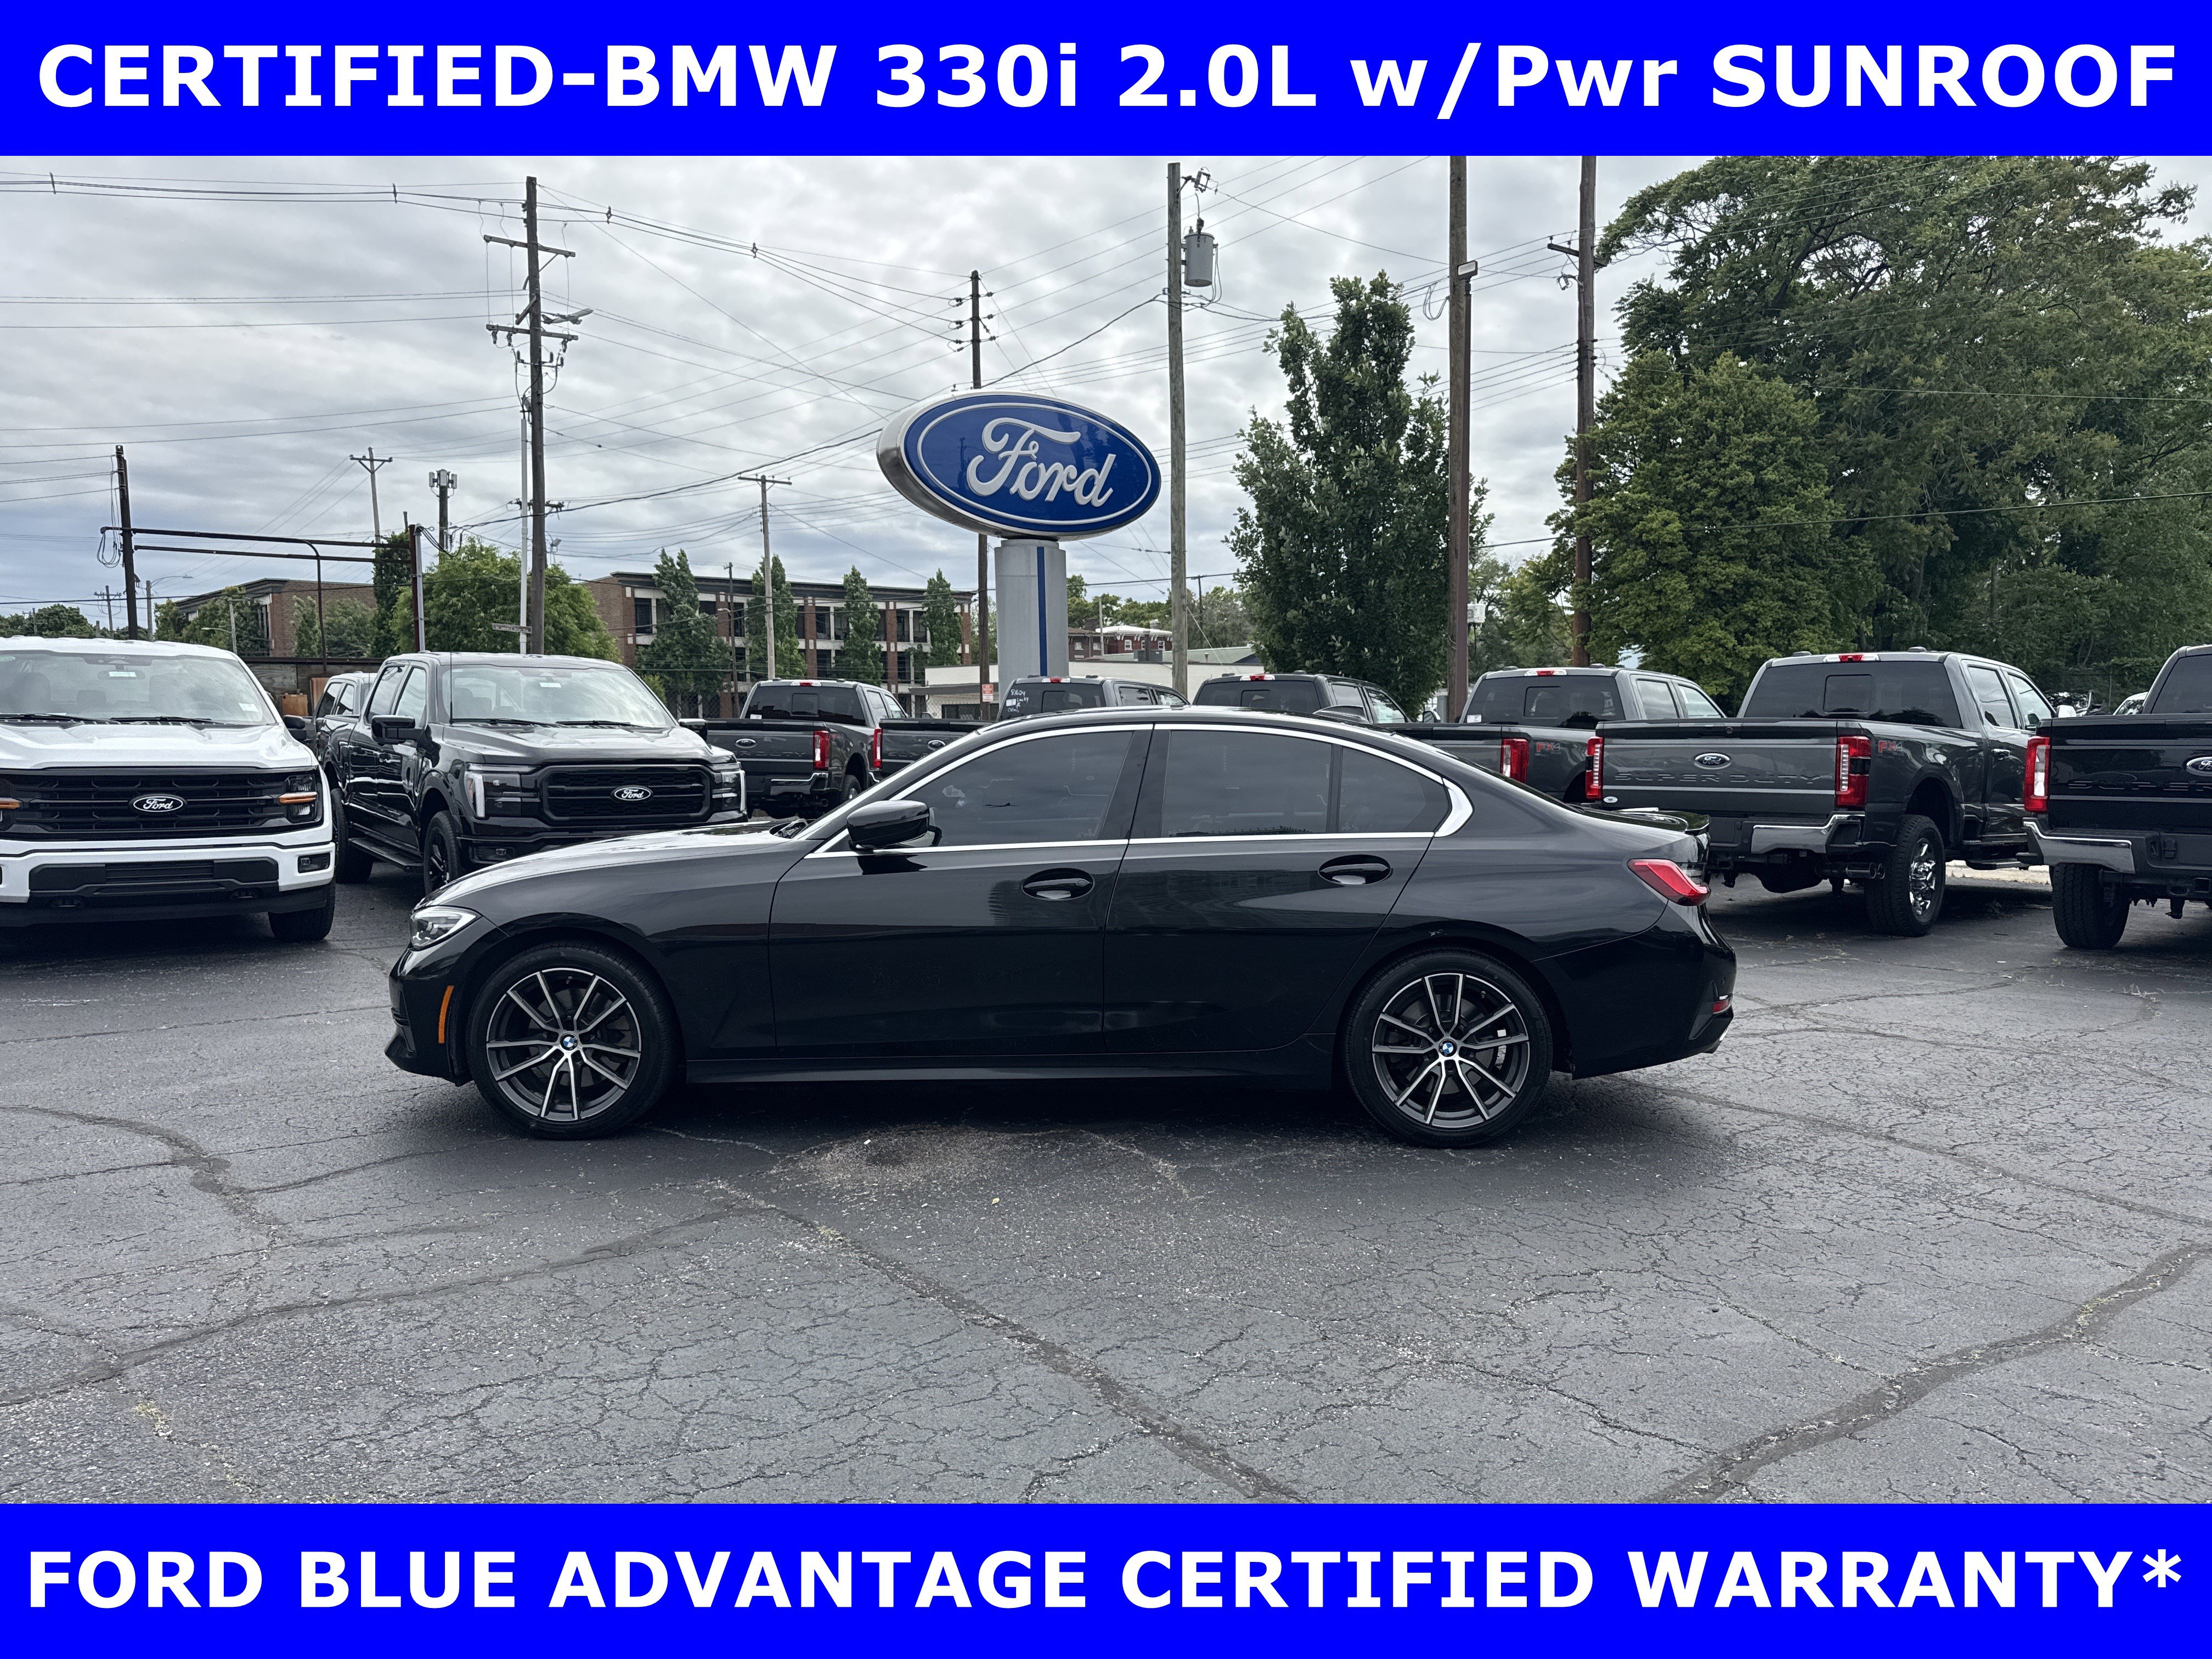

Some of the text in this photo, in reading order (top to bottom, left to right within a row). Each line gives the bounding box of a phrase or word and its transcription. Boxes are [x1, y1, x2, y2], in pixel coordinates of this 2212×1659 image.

[966, 417, 1117, 507] Ford
[1537, 742, 1562, 752] FX4
[1878, 741, 1904, 753] FX4
[1702, 756, 1722, 764] Ford
[1615, 772, 1820, 785] SUPER DUTY
[621, 789, 644, 798] Ford
[143, 798, 174, 809] Ford
